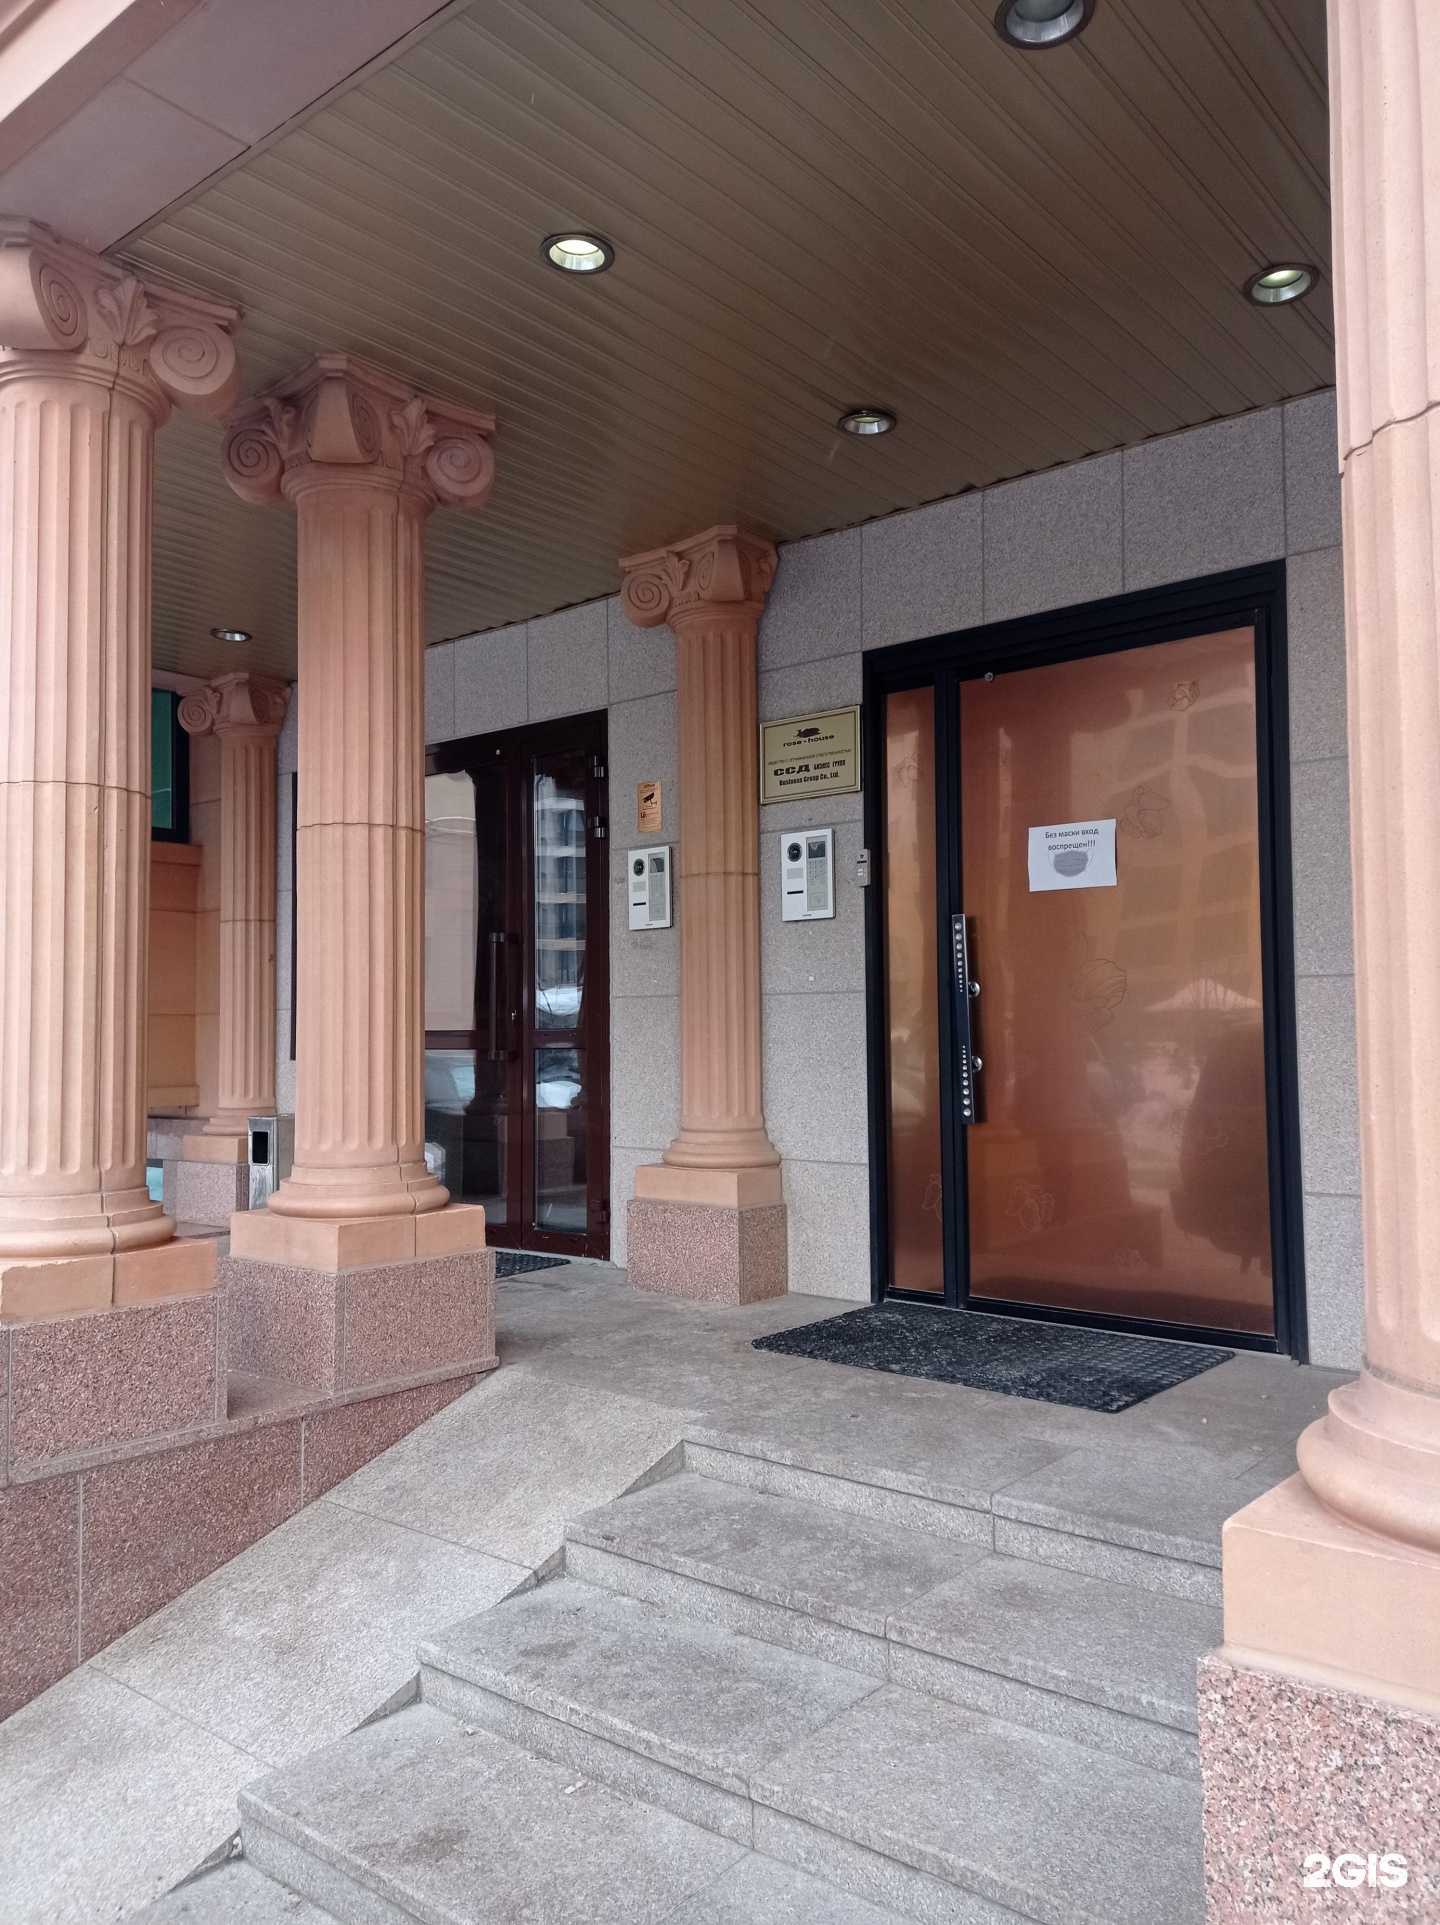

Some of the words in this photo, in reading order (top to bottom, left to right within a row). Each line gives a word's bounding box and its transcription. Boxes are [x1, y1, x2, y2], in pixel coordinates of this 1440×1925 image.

[1045, 831, 1057, 839] Без
[1058, 829, 1080, 838] маски
[1081, 828, 1099, 836] вход
